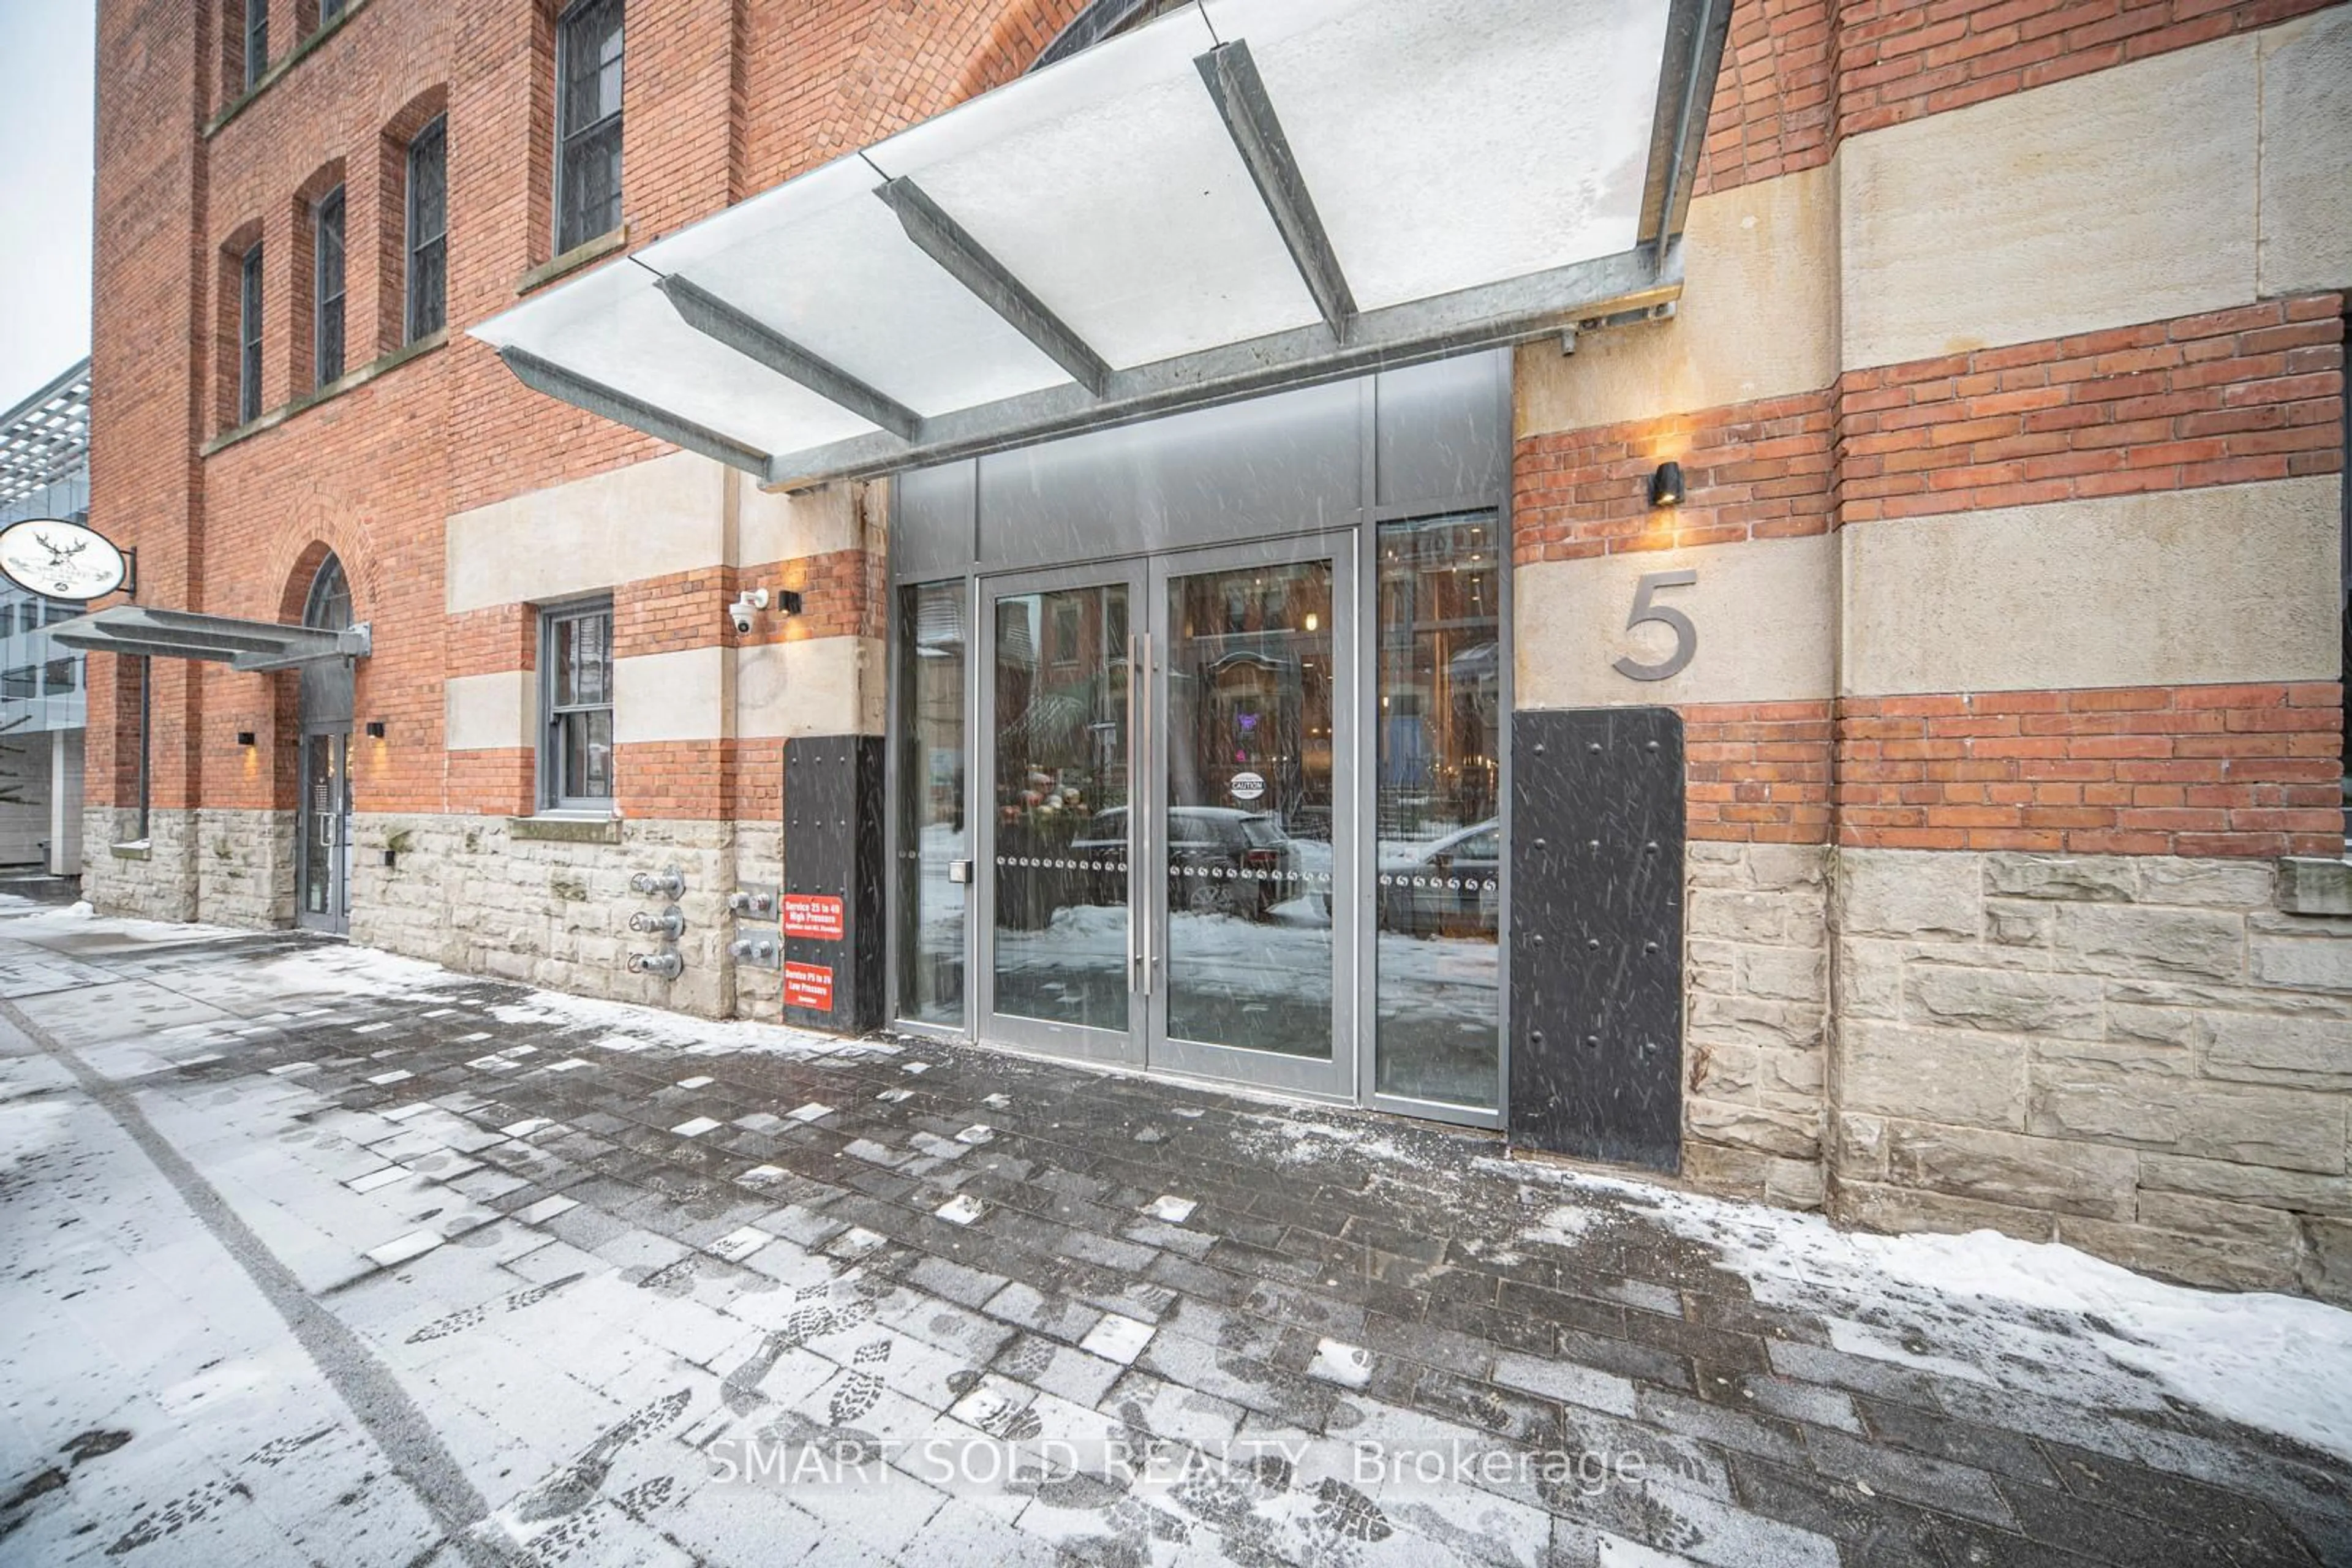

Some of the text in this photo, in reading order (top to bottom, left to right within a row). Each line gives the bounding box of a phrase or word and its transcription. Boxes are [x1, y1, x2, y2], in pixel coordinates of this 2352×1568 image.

[1613, 568, 1697, 682] 5
[1232, 781, 1263, 790] CAUTION
[785, 902, 810, 911] Service
[821, 903, 829, 913] to
[790, 911, 835, 923] High Pressure
[785, 970, 807, 981] Service
[816, 974, 823, 982] to
[788, 981, 827, 995] Low Pressure
